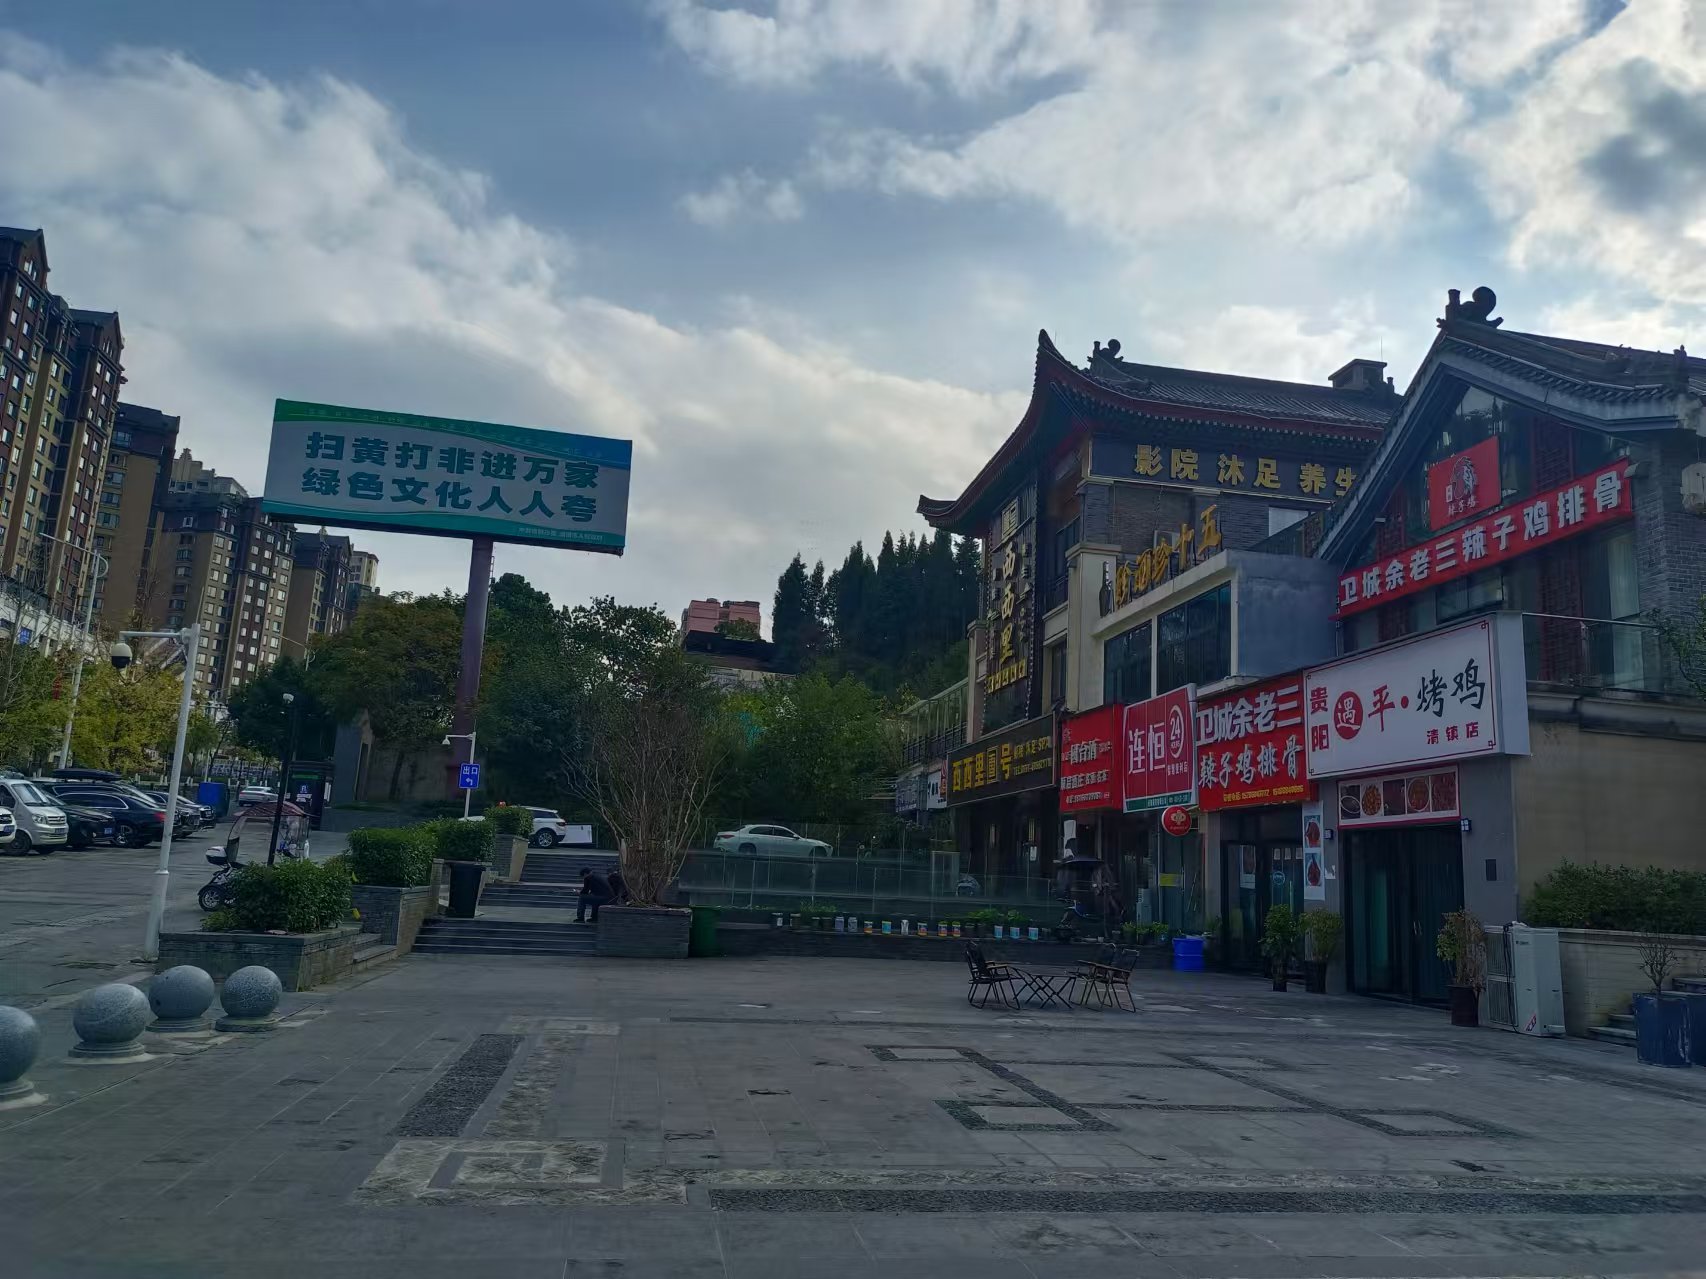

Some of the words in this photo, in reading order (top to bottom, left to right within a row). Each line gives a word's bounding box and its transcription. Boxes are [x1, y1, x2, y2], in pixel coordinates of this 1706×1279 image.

[305, 431, 600, 490] 扫黄打非进万家
[1134, 444, 1199, 480] 影院
[1217, 453, 1281, 490] 沐足
[1299, 462, 1357, 497] 养生
[301, 467, 597, 523] 绿色文化人人夸
[1340, 470, 1622, 606] 卫城余老三辣子鸡排骨
[1170, 716, 1181, 740] 24
[1309, 685, 1330, 753] 贵阳
[1426, 721, 1480, 745] 清镇店
[463, 765, 479, 775] 出口
[1128, 722, 1166, 775] 连恒
[1198, 735, 1303, 790] 辣子鸡排骨
